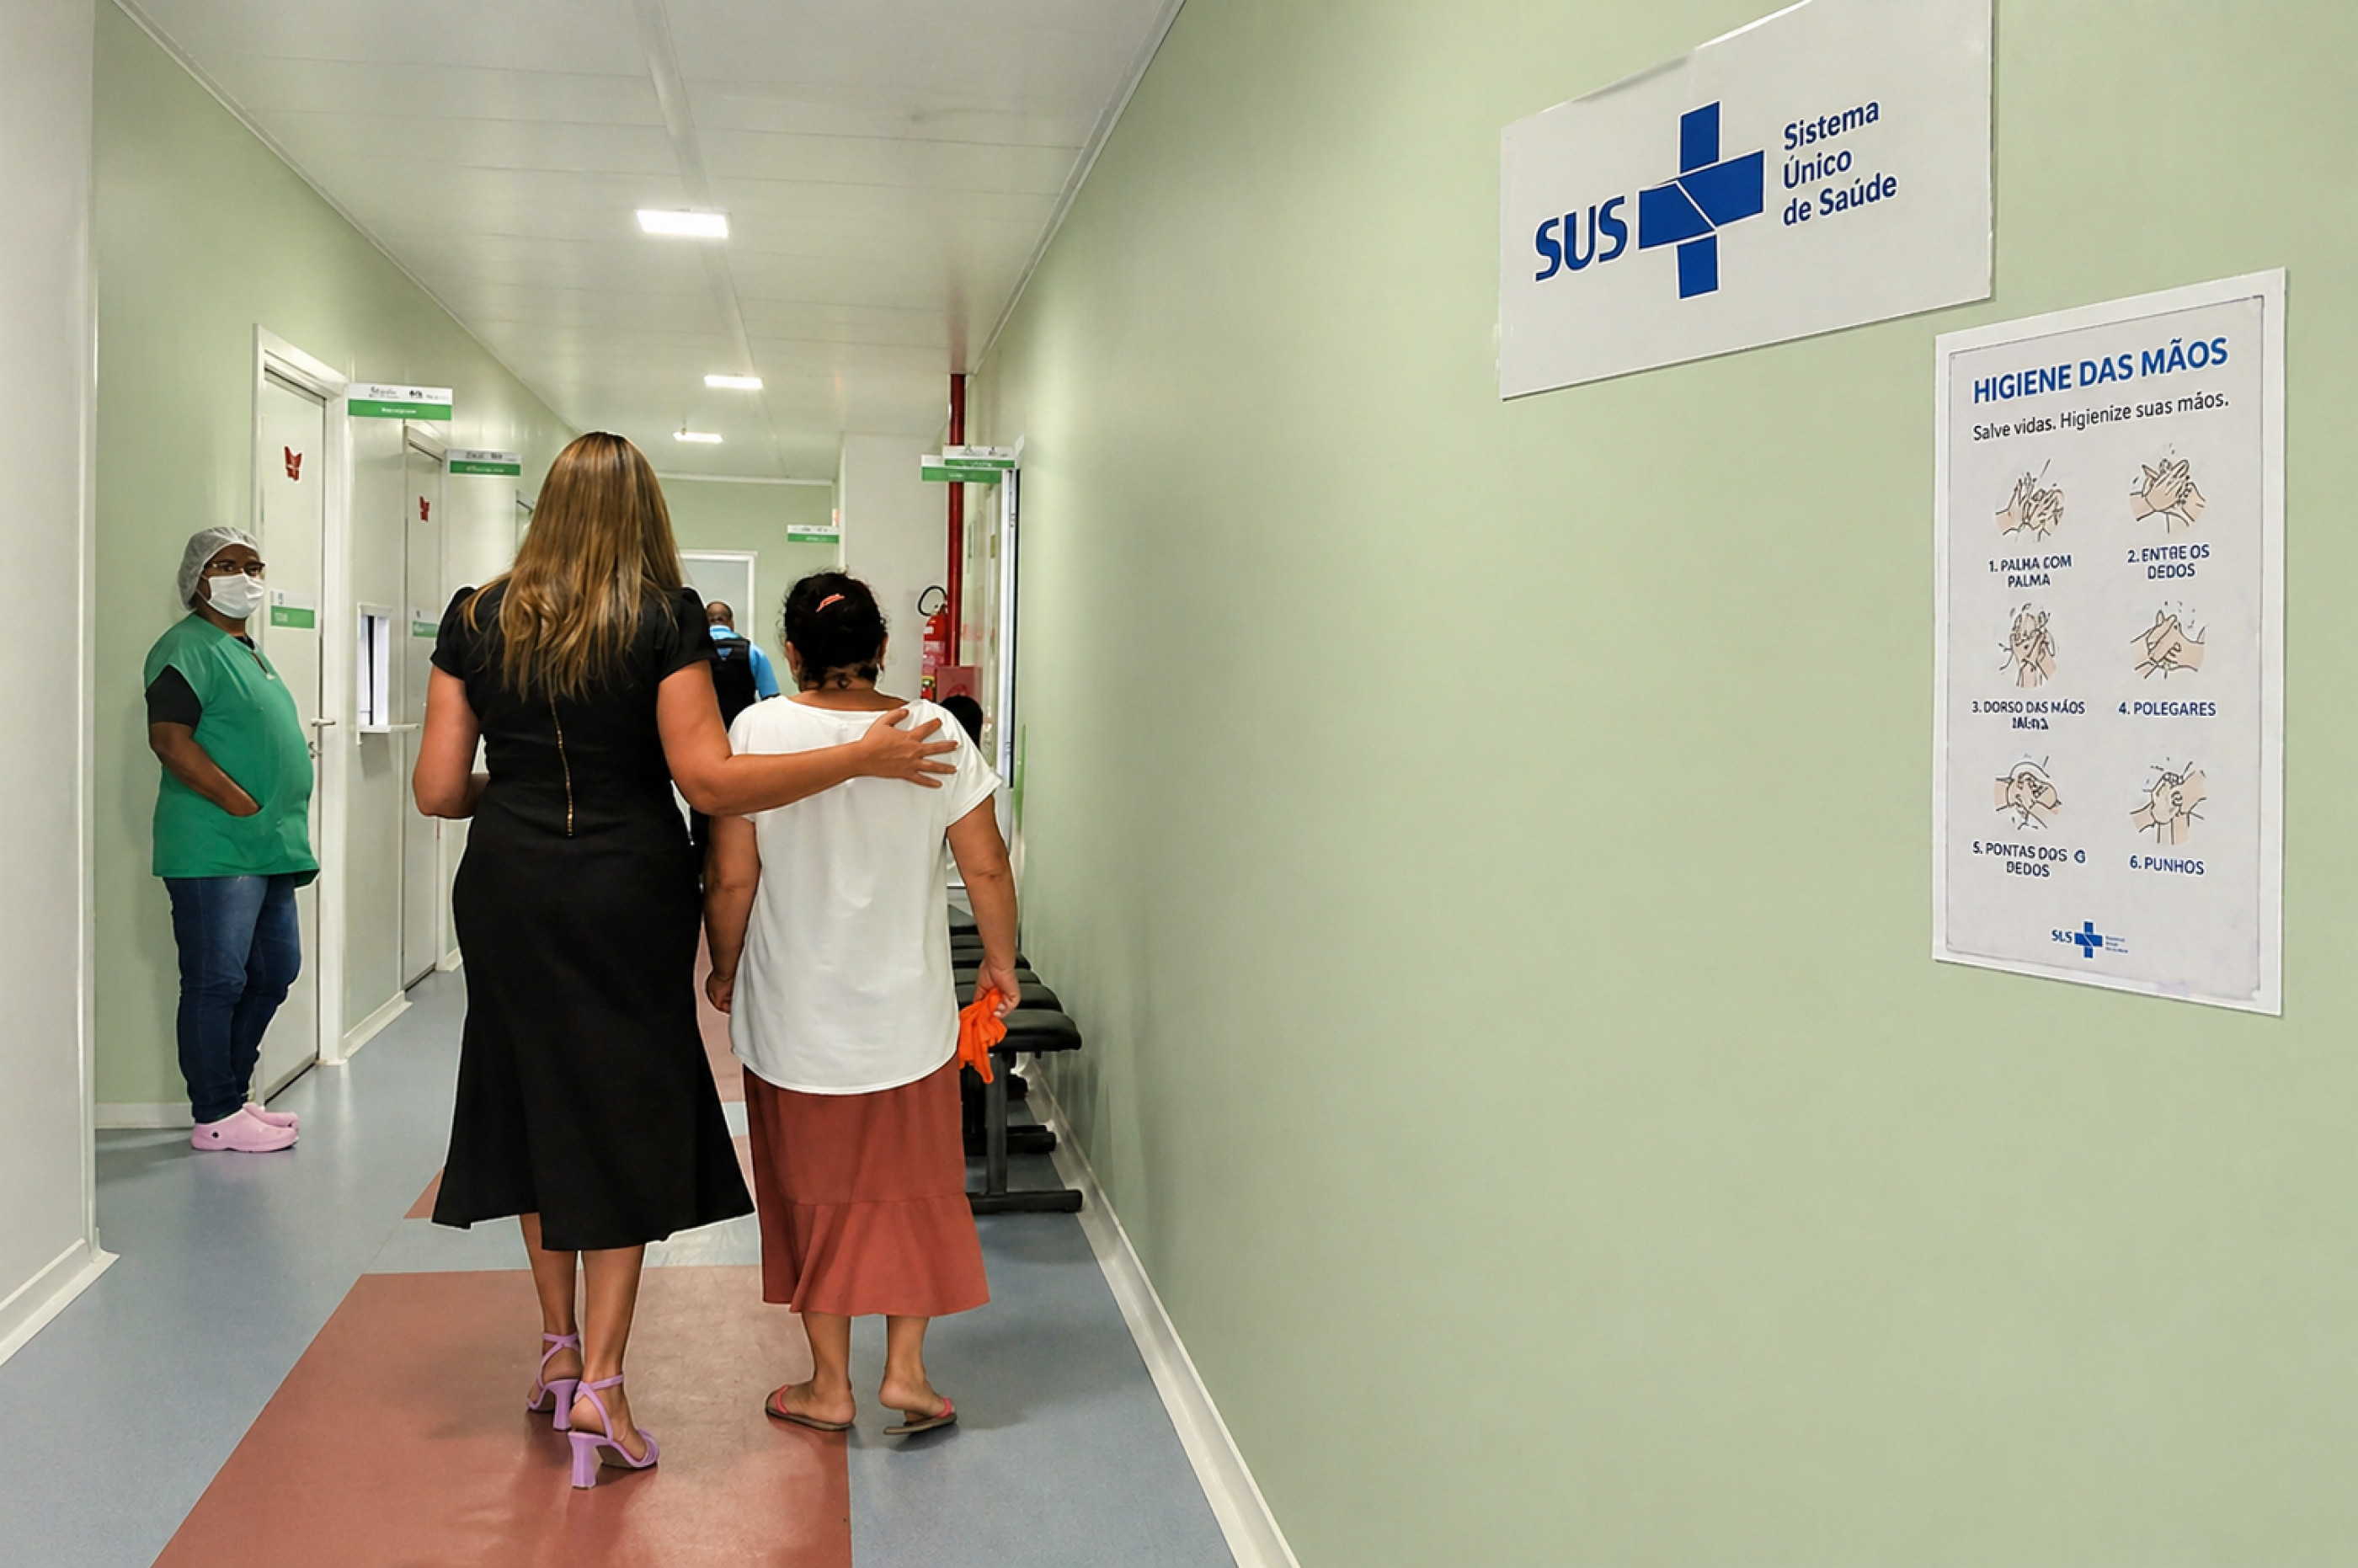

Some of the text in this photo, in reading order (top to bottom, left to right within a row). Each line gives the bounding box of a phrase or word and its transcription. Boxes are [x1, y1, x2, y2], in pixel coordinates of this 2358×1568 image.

[1784, 100, 1880, 151] Sistema
[1784, 150, 1853, 189] Único
[1783, 172, 1897, 227] de Saúde
[1535, 195, 1629, 282] SUS
[1974, 338, 2228, 404] HIGIENE DAS MÃOS
[1972, 422, 2011, 441] Salve
[2014, 416, 2057, 435] vidas.
[2060, 403, 2132, 431] Higienize
[2136, 399, 2174, 418] suas
[1988, 559, 1998, 573] 1.
[2043, 554, 2073, 569] COM
[2126, 548, 2140, 563] 2.
[2190, 543, 2211, 560] OS
[2008, 573, 2051, 588] PALMA
[1971, 700, 1982, 714] 3.
[2118, 701, 2217, 717] 4. POLEGARES
[1985, 842, 2035, 859] PONTAS
[2038, 846, 2067, 862] DOS
[2129, 854, 2205, 876] 6. PUNHOS
